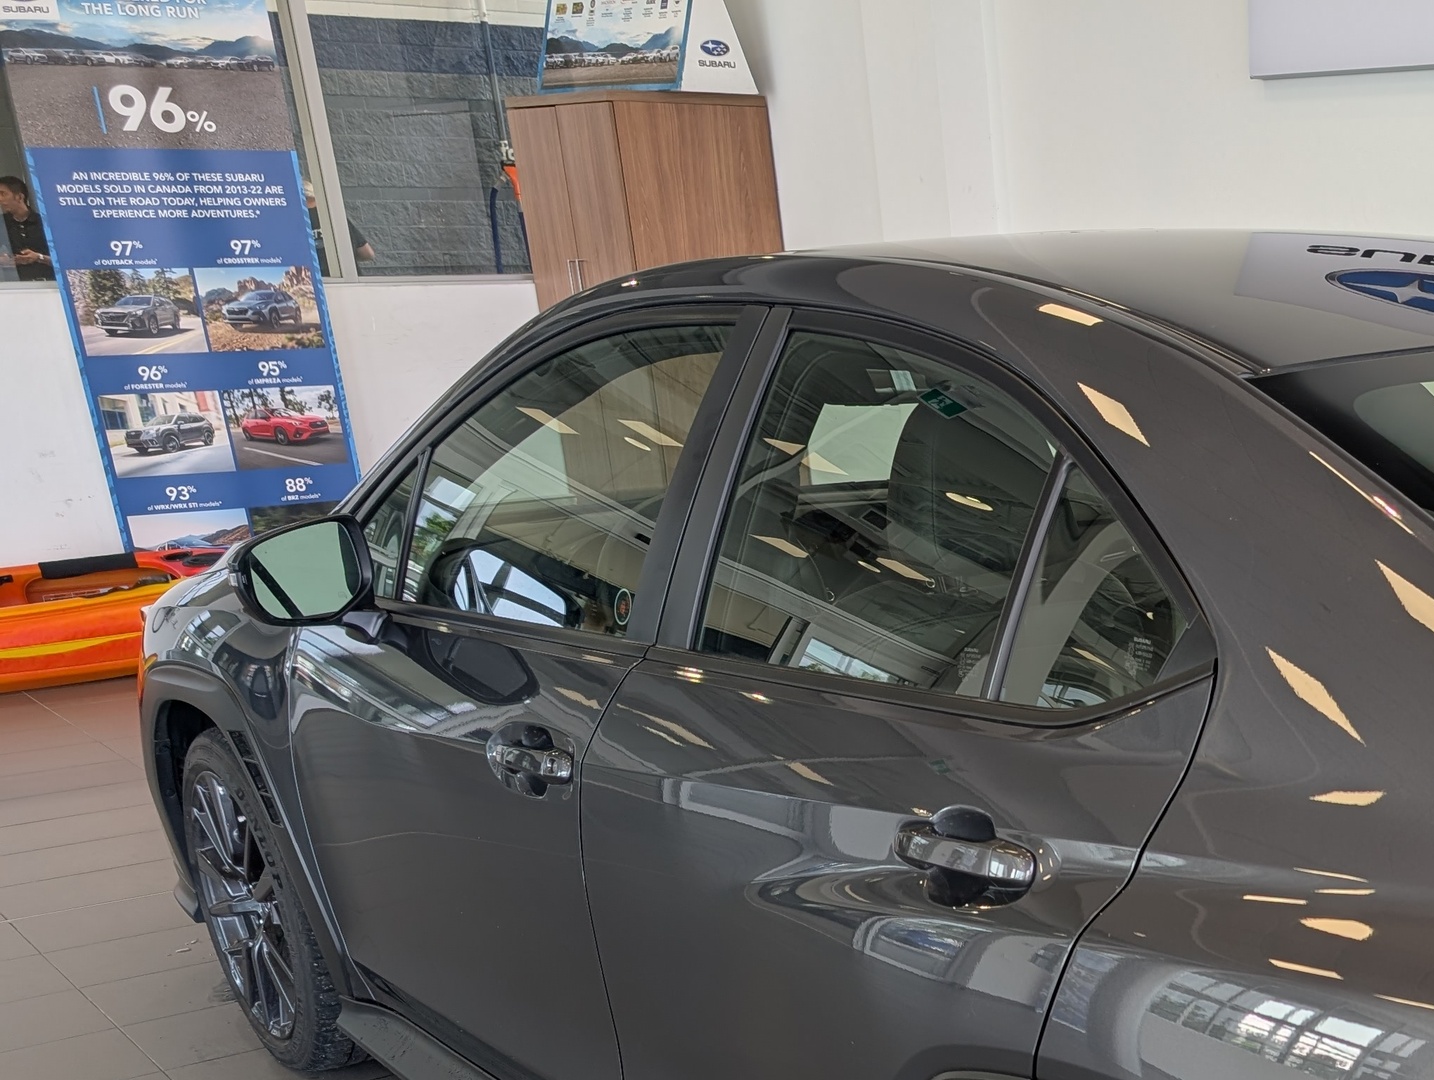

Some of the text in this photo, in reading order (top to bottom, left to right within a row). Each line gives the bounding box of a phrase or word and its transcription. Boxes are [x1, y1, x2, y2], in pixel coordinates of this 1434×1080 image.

[2, 5, 50, 14] SUBARU
[81, 2, 113, 15] THE
[116, 3, 162, 17] LONG
[165, 5, 200, 19] RUN
[697, 59, 736, 69] SUBARU
[107, 84, 217, 133] 96%
[72, 171, 265, 182] AN INCREDIBLE 96% OF THESE SUBARU
[56, 184, 285, 195] MODELS SOLD IN CANADA FROM 2013-22 ARE
[58, 197, 287, 207] STILL ON THE ROAD TODAY, HELPING OWNERS
[92, 209, 156, 218] EXPERIENCE
[157, 209, 189, 218] MORE
[110, 240, 143, 256] 97%
[230, 239, 261, 255] 97%
[217, 257, 223, 265] of
[137, 365, 168, 381] 96%
[258, 360, 287, 377] 95%
[131, 382, 164, 390] FORESTER
[254, 377, 281, 385] IMPREZA
[285, 477, 313, 492] 88%
[165, 485, 197, 501] 93%
[154, 502, 188, 511] WRX/WRX
[235, 787, 283, 889] DUNLOP
